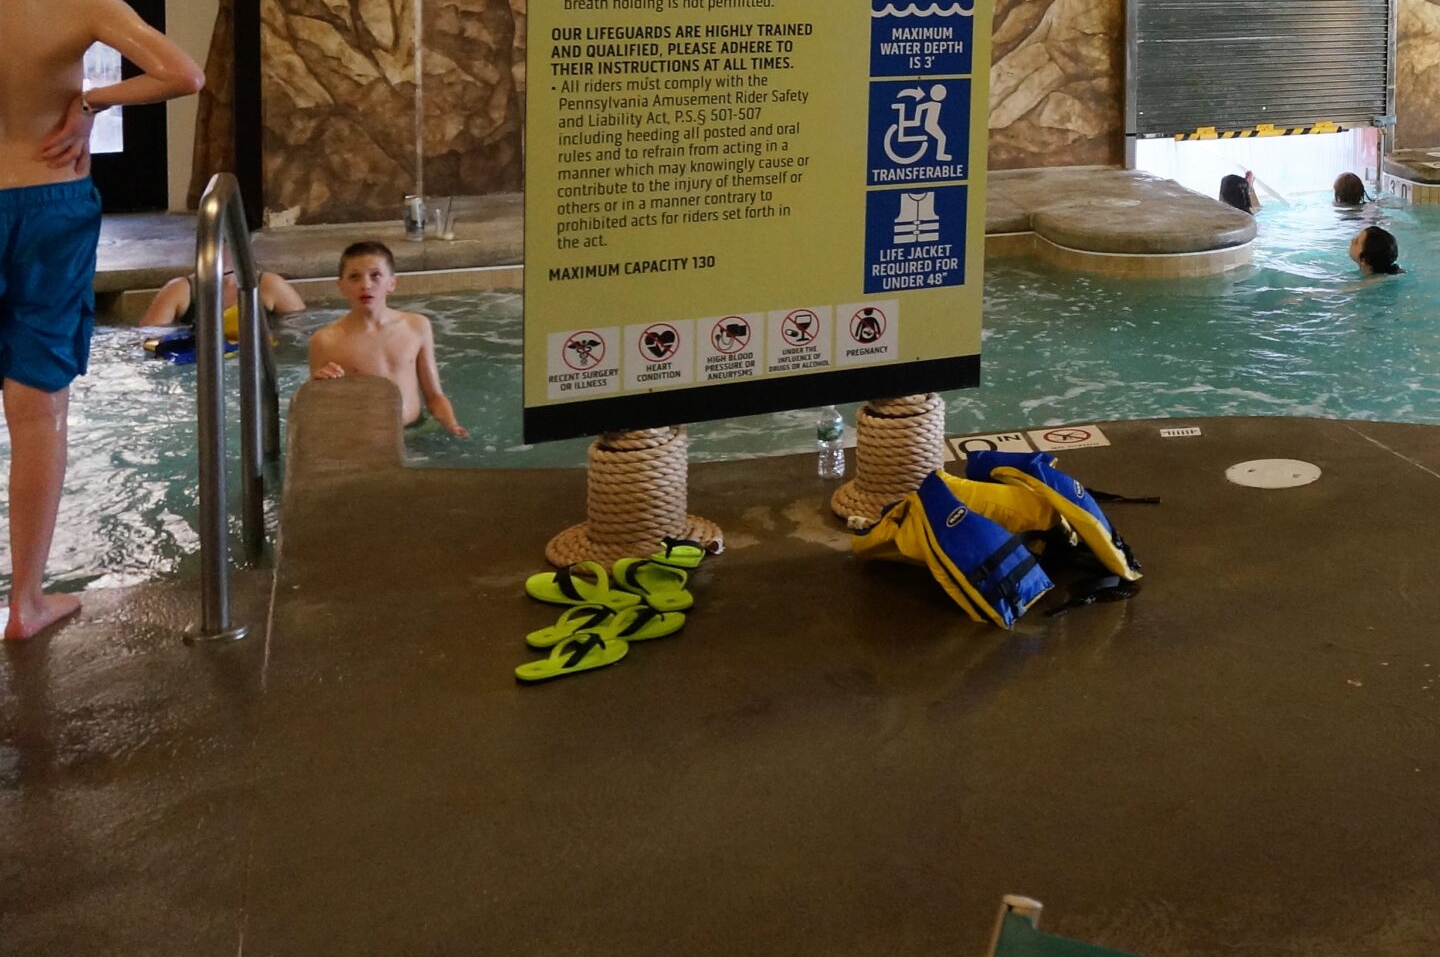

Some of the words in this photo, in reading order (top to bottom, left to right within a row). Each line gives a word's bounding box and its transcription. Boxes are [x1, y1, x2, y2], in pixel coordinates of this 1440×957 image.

[552, 28, 582, 41] OUR
[587, 26, 671, 40] LIFEGUARDS
[675, 25, 701, 38] ARE
[705, 24, 753, 37] HIGHLY
[757, 23, 812, 36] TRAINED
[892, 27, 953, 40] MAXIMUM
[551, 45, 581, 58] AND
[668, 42, 716, 55] PLEASE
[721, 41, 772, 54] ADHERE
[776, 40, 793, 53] TO
[880, 42, 920, 55] WATER
[924, 41, 963, 54] DEPTH
[550, 62, 593, 76] THEIR
[598, 59, 699, 74] INSTRUCTIONS
[703, 59, 720, 71] AT
[723, 58, 747, 70] ALL
[751, 57, 794, 70] TIMES.
[910, 56, 921, 68] IS
[561, 80, 579, 93] All
[584, 79, 622, 92] riders
[627, 77, 661, 91] must
[664, 76, 712, 92] comply
[715, 74, 743, 87] with
[748, 74, 768, 87] the
[559, 95, 648, 113] Pennsylvania
[652, 92, 732, 107] Amusement
[736, 91, 768, 104] Rider
[772, 89, 809, 104] Safety
[558, 115, 584, 128] and
[589, 113, 642, 128] Liability
[559, 131, 622, 147] including
[627, 128, 679, 144] heeding
[683, 126, 699, 139] all
[704, 124, 746, 142] posted
[750, 123, 773, 136] and
[777, 122, 800, 135] oral
[558, 149, 591, 163] rules
[596, 147, 621, 161] and
[625, 148, 638, 159] to
[643, 145, 684, 158] refrain
[689, 143, 719, 156] from
[723, 141, 762, 156] acting
[766, 142, 777, 152] in
[781, 141, 788, 151] a
[558, 168, 611, 180] manner
[614, 163, 654, 177] which
[659, 164, 686, 177] may
[690, 157, 755, 174] knowingly
[758, 157, 794, 169] cause
[797, 157, 809, 167] or
[872, 165, 963, 181] TRANSFERABLE
[557, 182, 628, 198] contribute
[632, 181, 645, 193] to
[649, 179, 670, 192] the
[675, 177, 712, 193] injury
[716, 174, 729, 188] of
[732, 171, 788, 187] themself
[790, 173, 803, 183] or
[557, 201, 600, 215] others
[604, 201, 618, 212] or
[622, 200, 634, 210] in
[638, 199, 646, 210] a
[650, 196, 701, 209] manner
[704, 192, 756, 205] contrary
[760, 190, 772, 201] to
[557, 215, 627, 236] prohibited
[631, 214, 657, 227] acts
[661, 212, 679, 224] for
[683, 210, 719, 223] riders
[722, 208, 741, 220] set
[745, 205, 774, 218] forth
[779, 204, 790, 216] in
[557, 236, 579, 250] the
[583, 235, 607, 247] act.
[880, 248, 904, 261] LIFE
[907, 244, 952, 259] JACKET
[549, 263, 619, 281] MAXIMUM
[624, 258, 688, 275] CAPACITY
[692, 256, 715, 269] 130
[872, 260, 932, 276] REQUIRED
[936, 258, 958, 271] FOR
[883, 275, 924, 289] UNDER
[707, 355, 726, 363] HIGH
[729, 352, 754, 361] BLOOD
[778, 354, 811, 363] INFLUENCE
[782, 347, 804, 355] UNDER
[846, 346, 888, 357] PREGNANCY
[646, 362, 672, 372] HEART
[705, 361, 743, 372] PRESSURE
[745, 360, 755, 368] OR
[769, 364, 790, 372] DRUGS
[548, 372, 580, 383] RECENT
[582, 368, 619, 379] SURGERY
[637, 370, 681, 382] CONDITION
[708, 369, 752, 380] ANEURYSMS
[560, 383, 572, 391] OR
[574, 379, 607, 389] ILLNESS
[997, 434, 1022, 443] IN
